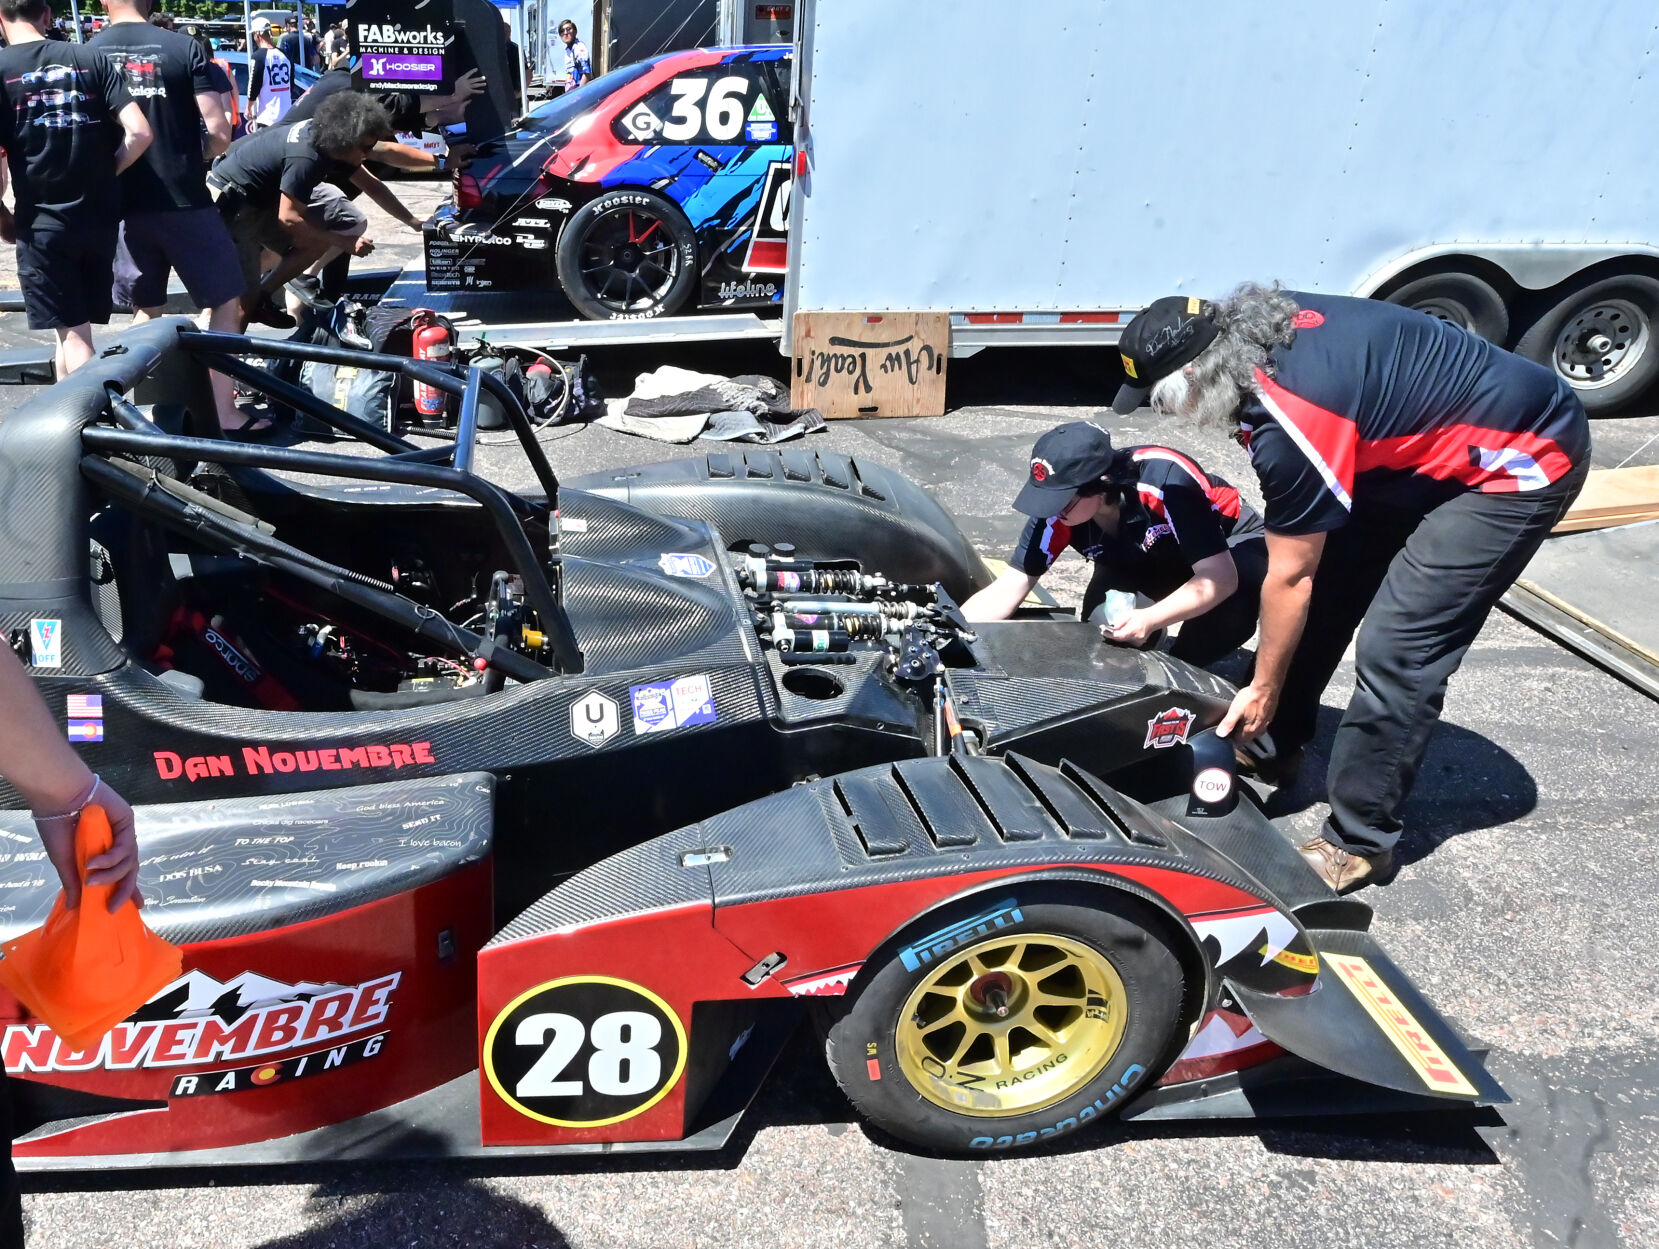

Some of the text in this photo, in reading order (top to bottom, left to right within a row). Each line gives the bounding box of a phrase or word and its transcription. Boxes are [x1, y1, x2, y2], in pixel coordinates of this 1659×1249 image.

[358, 24, 445, 43] FABworks
[360, 46, 399, 54] MACHINE
[413, 47, 445, 55] DESIGN
[266, 63, 290, 86] 123
[386, 62, 436, 71] HOOSIER
[662, 76, 749, 141] 36
[38, 654, 55, 662] OFF
[586, 703, 604, 723] U
[153, 741, 436, 783] DAN NOVEMBRE
[1199, 780, 1228, 791] TOW
[356, 799, 445, 812] God bless America
[402, 814, 442, 830] SEND IT
[234, 836, 295, 846] TO THE TOP
[410, 838, 431, 847] love
[433, 838, 462, 848] bacon
[897, 898, 1024, 973] PIRELLI
[1338, 961, 1460, 1085] PIRELLI
[514, 1010, 662, 1098] 28
[175, 1035, 385, 1096] RACING
[995, 1053, 1068, 1090] RACING
